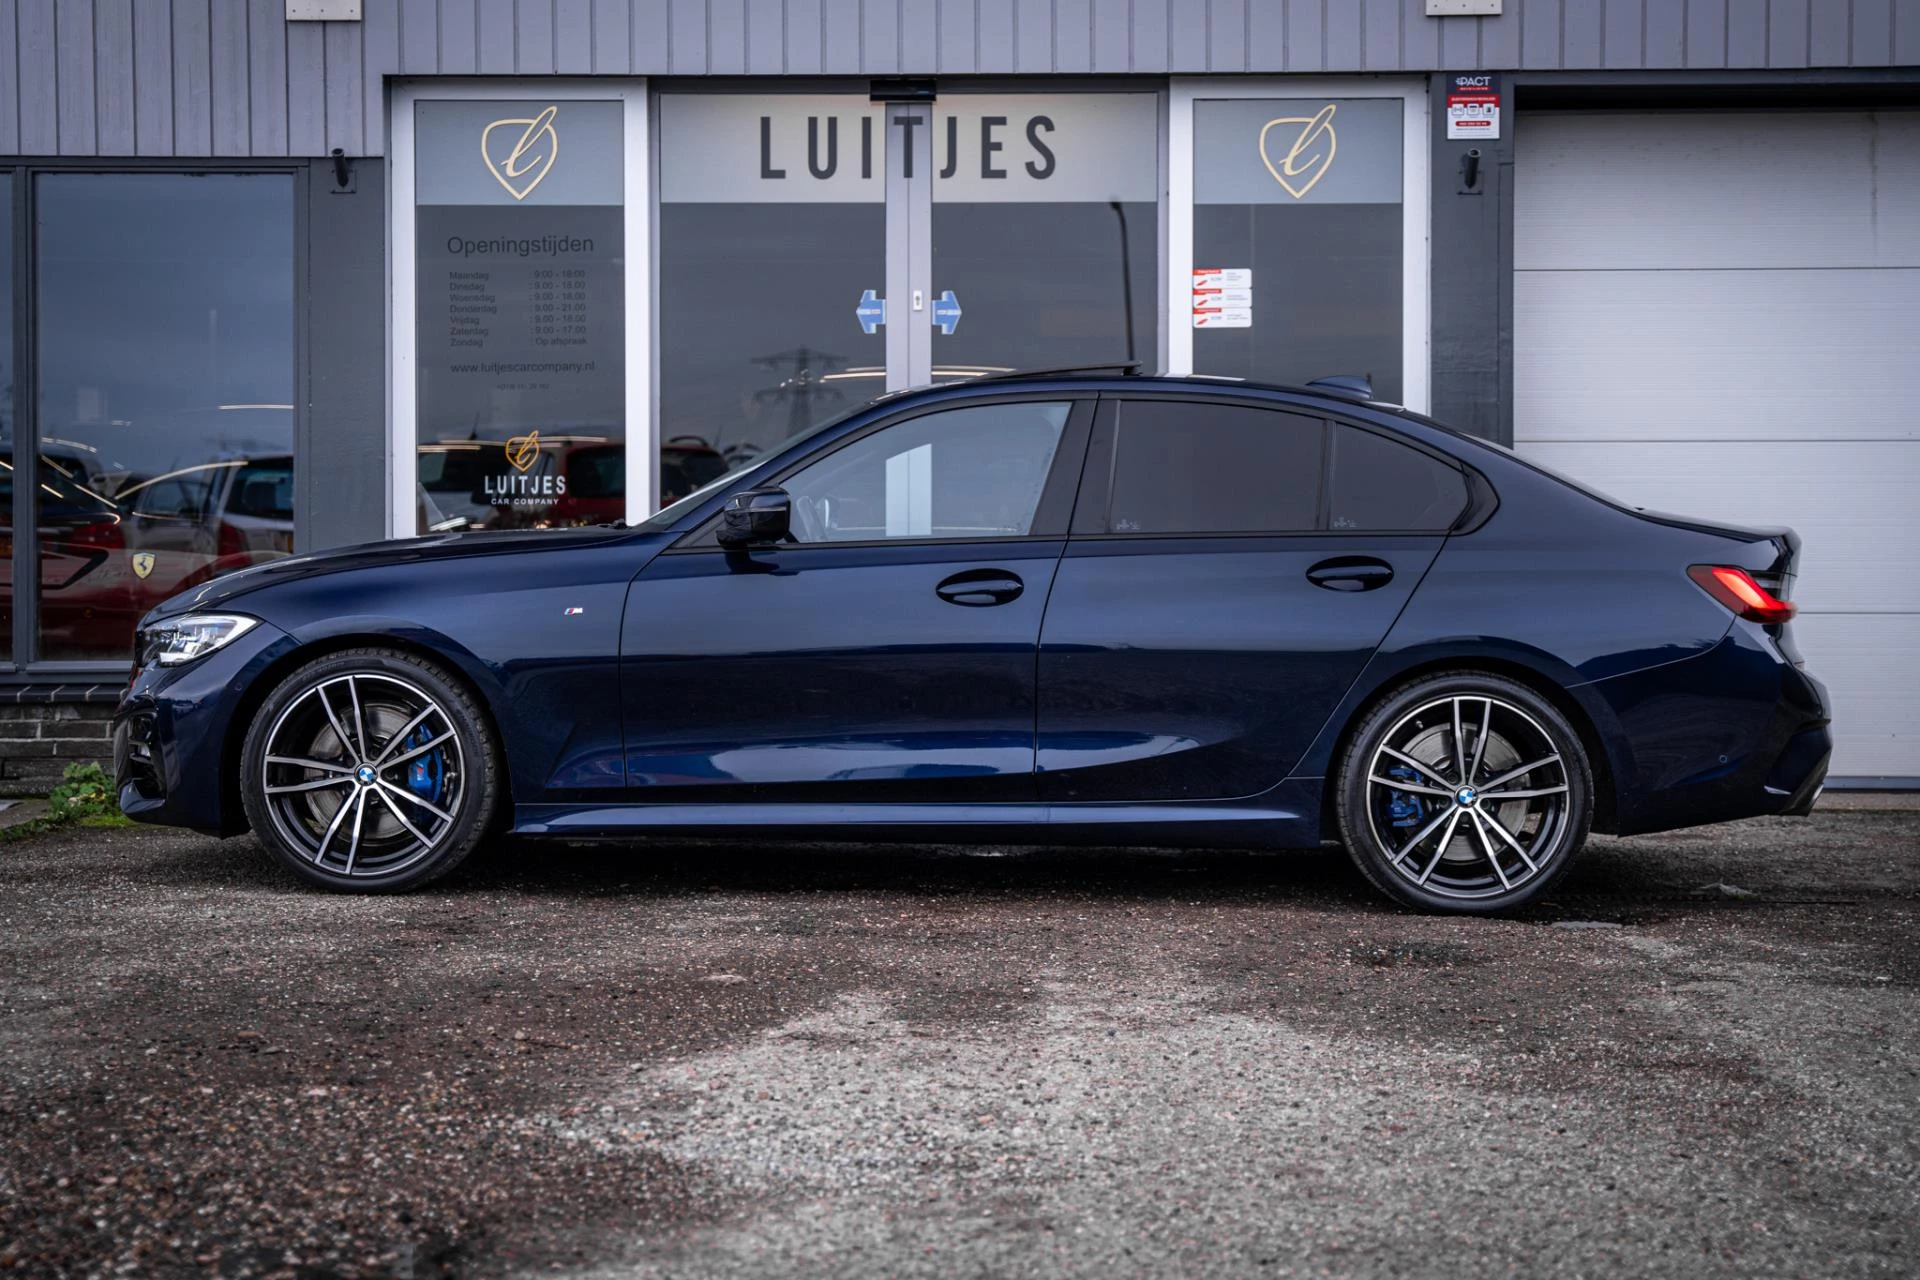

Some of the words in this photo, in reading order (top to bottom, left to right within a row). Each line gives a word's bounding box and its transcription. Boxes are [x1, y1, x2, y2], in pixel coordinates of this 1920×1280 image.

[760, 115, 1056, 180] LUITJES
[447, 235, 594, 258] Openingstijden
[450, 360, 595, 376] www.luitjescarcompany.nl
[484, 475, 566, 495] LUITJES
